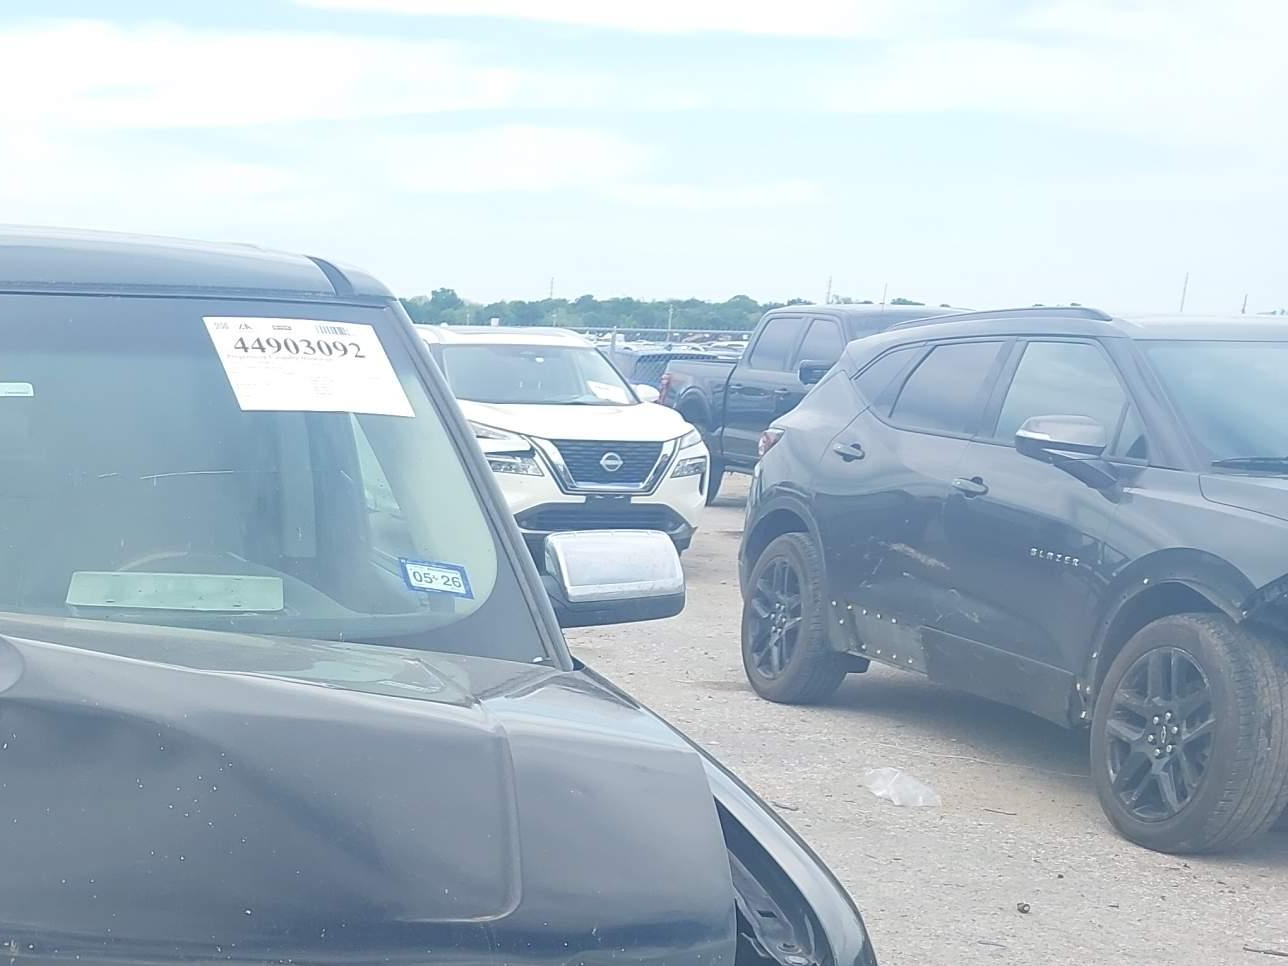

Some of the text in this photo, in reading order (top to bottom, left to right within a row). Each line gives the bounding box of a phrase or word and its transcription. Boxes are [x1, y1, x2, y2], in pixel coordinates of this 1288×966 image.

[233, 336, 366, 359] 44903092
[412, 571, 462, 588] 05 26
